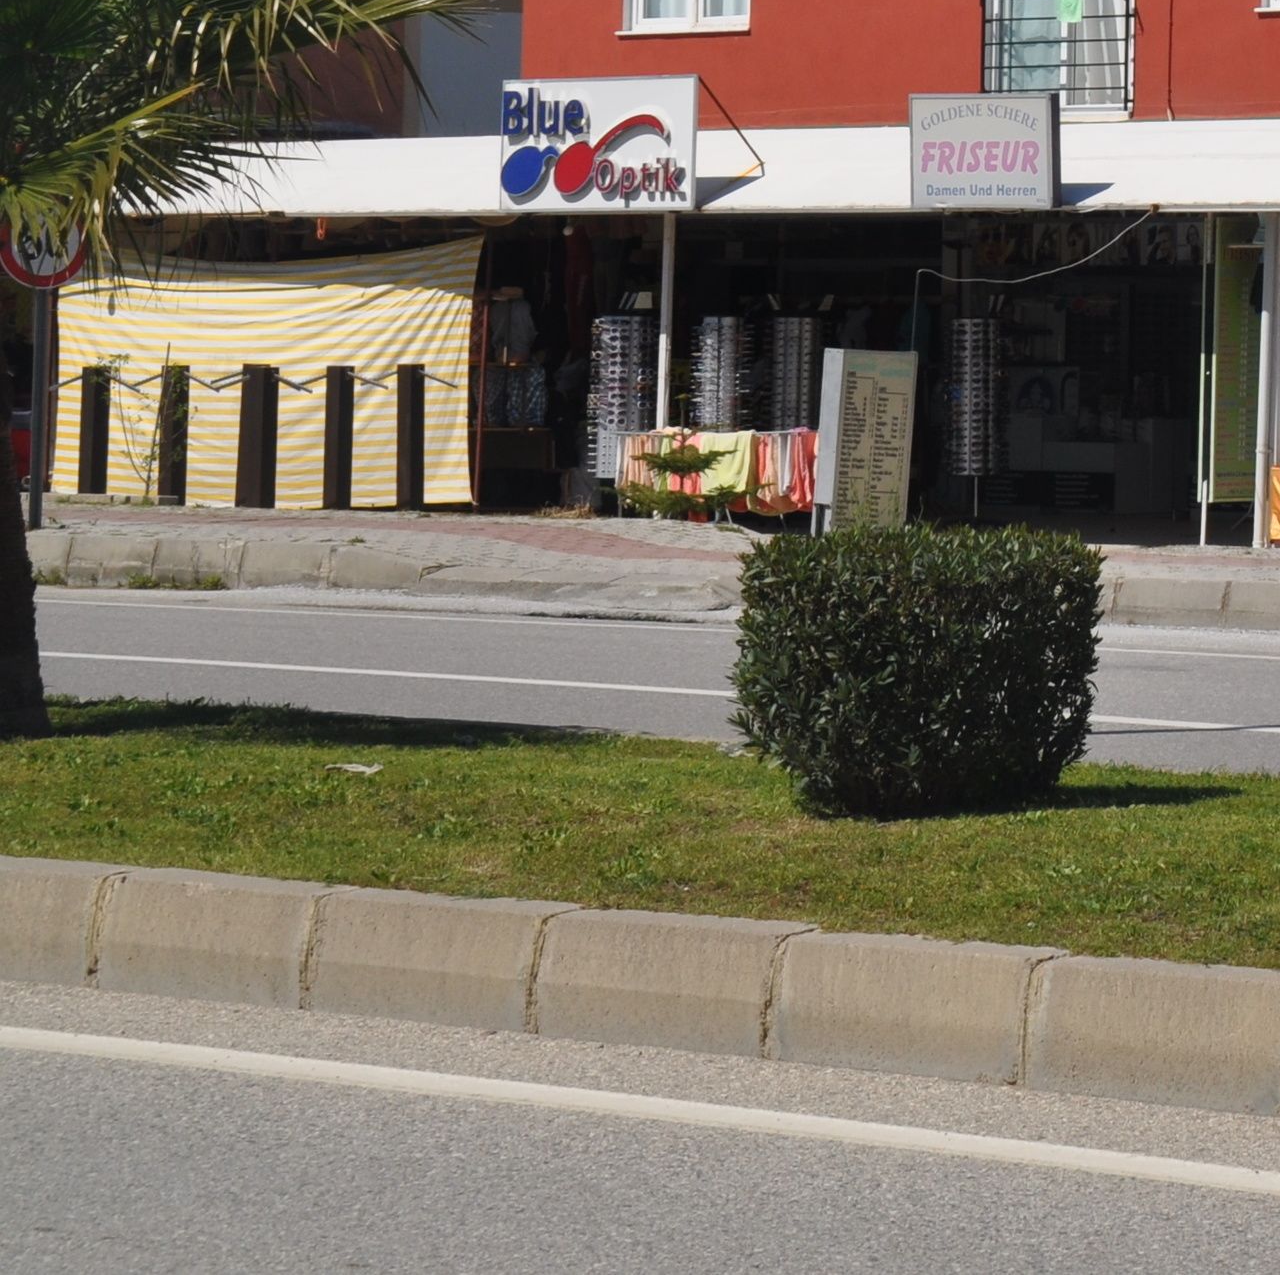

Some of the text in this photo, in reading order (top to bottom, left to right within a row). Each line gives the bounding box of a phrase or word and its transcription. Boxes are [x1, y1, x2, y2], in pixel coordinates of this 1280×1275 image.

[503, 87, 586, 136] Blue
[920, 103, 1039, 132] GOLDENE SCHERE
[920, 140, 1040, 175] FRISEUR
[594, 157, 681, 200] Optik
[926, 184, 1037, 196] Damen Und Herren
